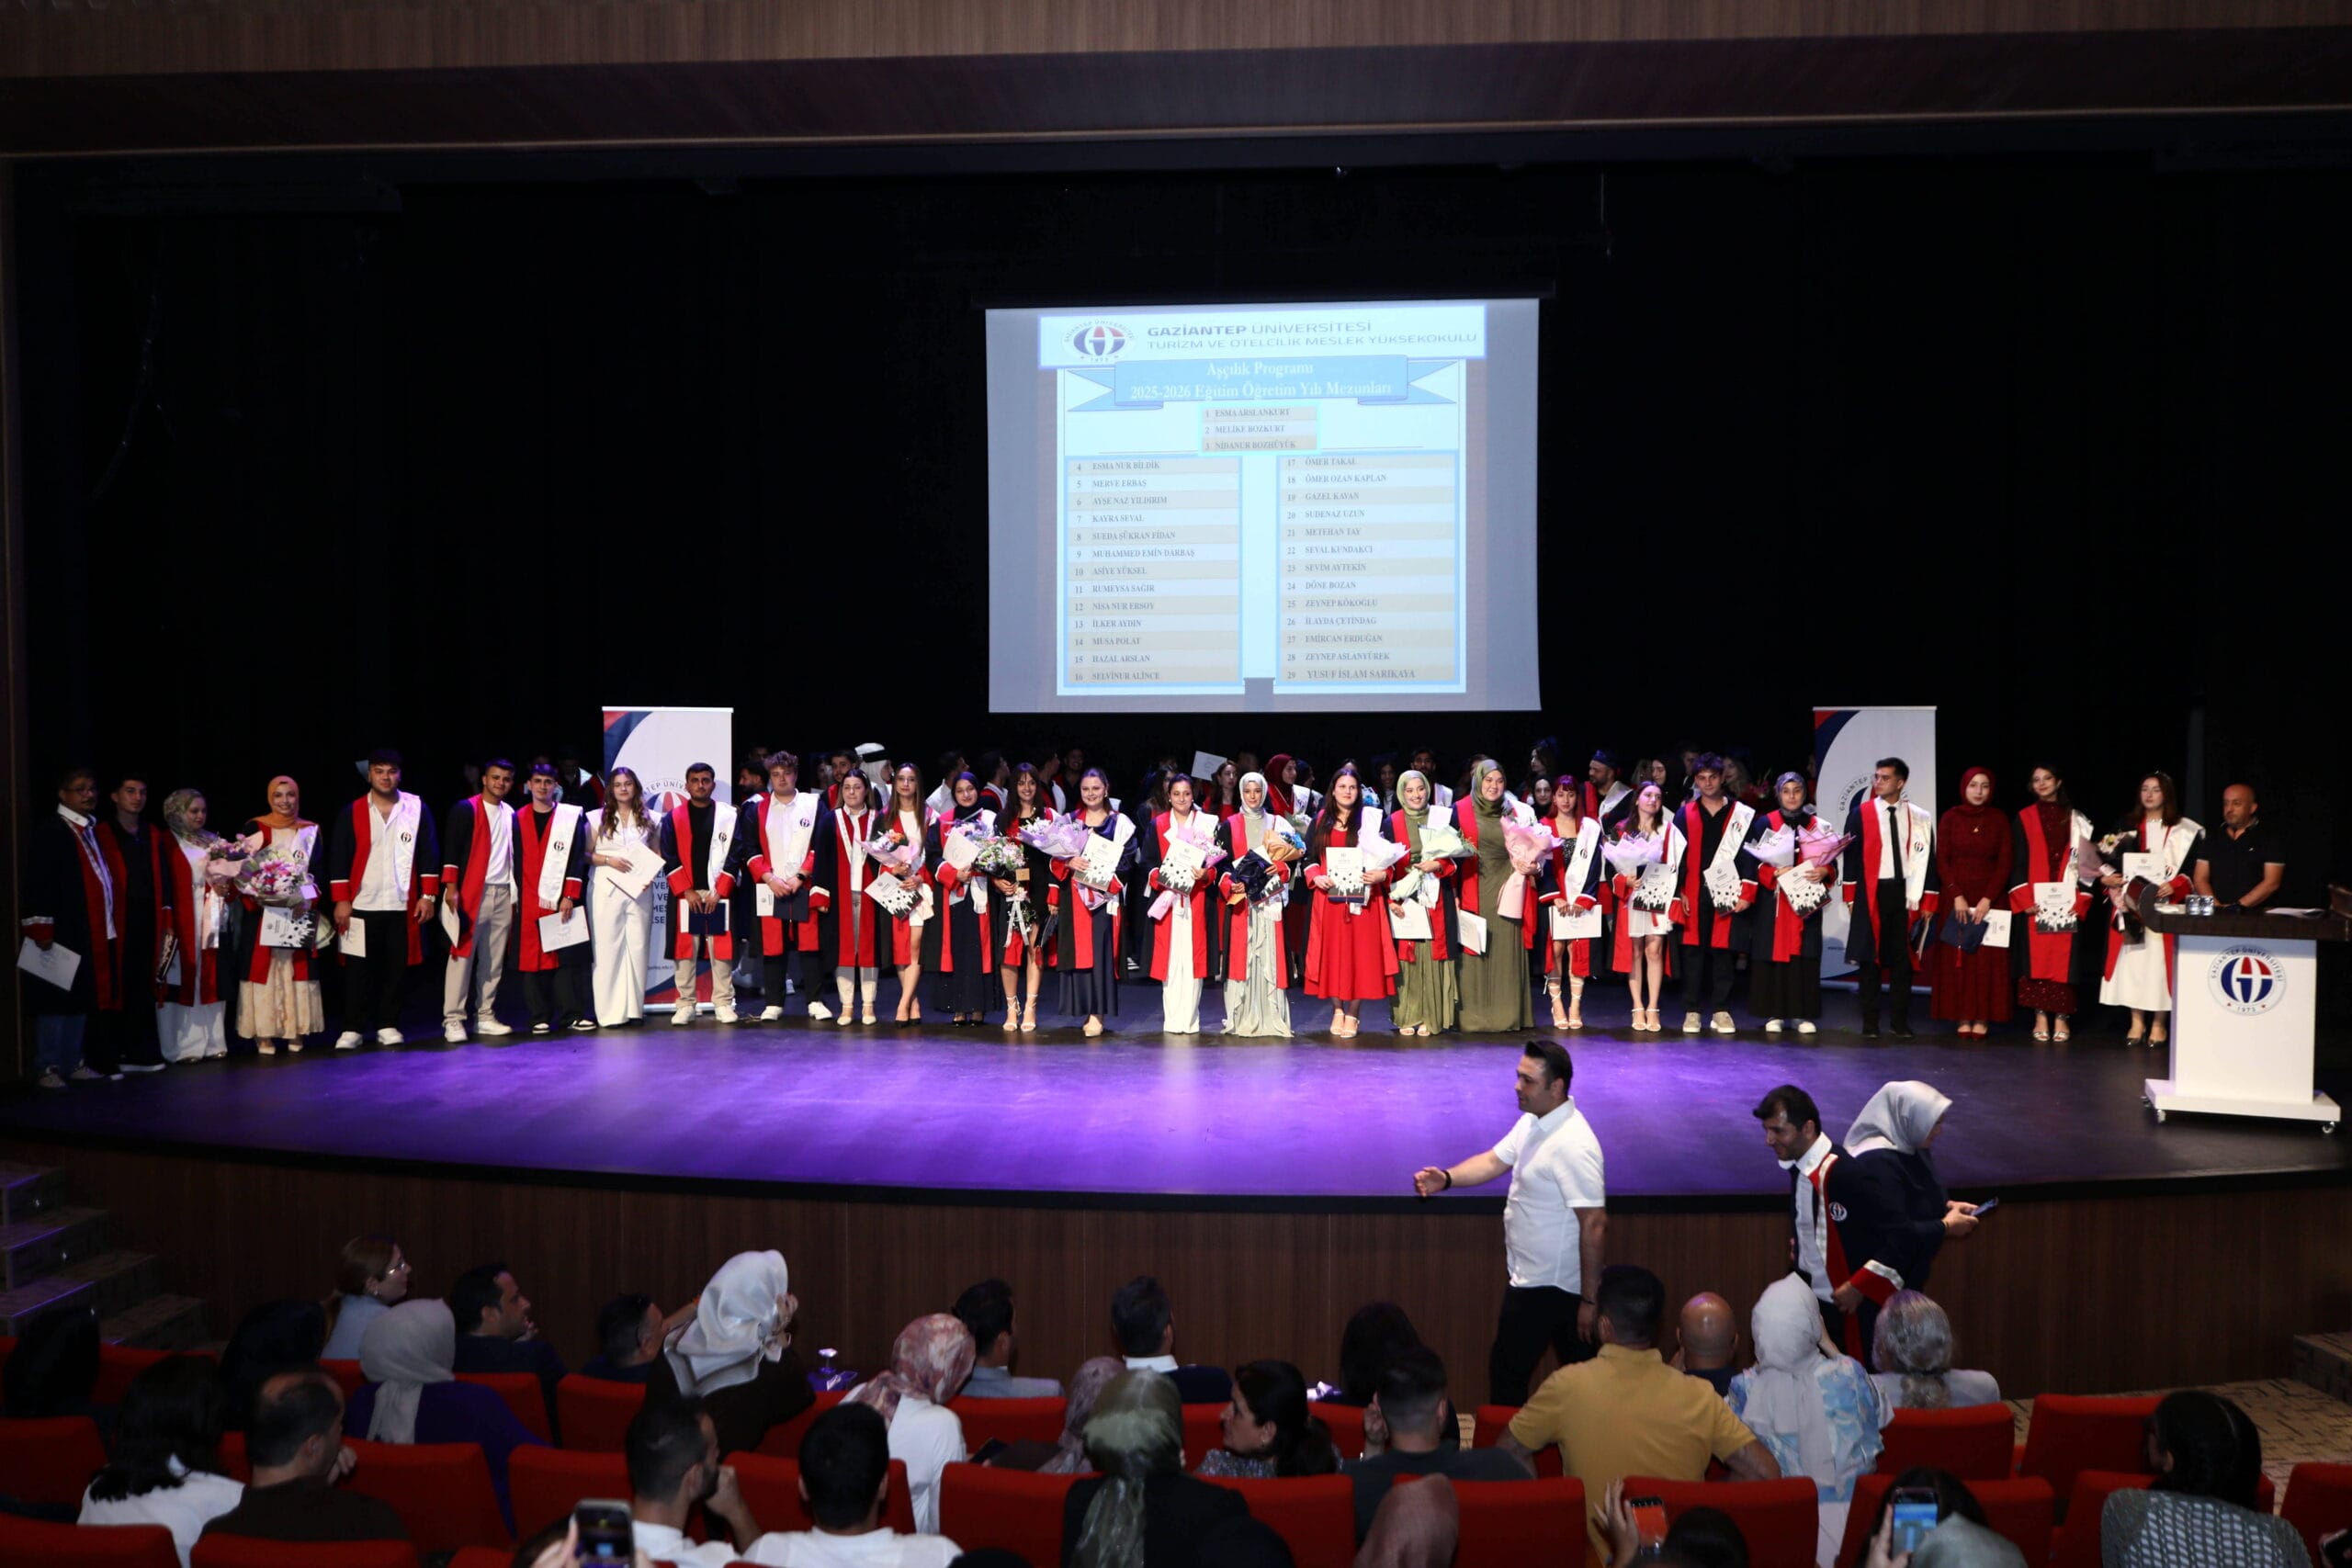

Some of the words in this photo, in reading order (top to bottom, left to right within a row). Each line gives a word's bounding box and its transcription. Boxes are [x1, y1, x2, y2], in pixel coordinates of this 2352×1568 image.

[1148, 323, 1247, 337] GAZİANTEP
[1251, 319, 1372, 334] ÜNİVERSİTESİ
[1147, 338, 1204, 350] TURİZM
[1207, 338, 1227, 349] VE
[1305, 335, 1364, 346] MESLEK
[1368, 333, 1477, 344] YÜKSEKOKULU
[1206, 363, 1250, 378] Aşçılık
[1254, 362, 1314, 378] Programı
[1131, 385, 1192, 399] 2025-2026
[1195, 383, 1238, 401] Eğitim
[1242, 381, 1296, 400] Öğretim
[1300, 382, 1323, 396] Yılı
[1326, 381, 1392, 396] Mezunları
[1215, 410, 1238, 418] ESMA
[1238, 408, 1290, 417] ARSLANKURT
[1215, 424, 1246, 434] MELİKE
[1248, 424, 1285, 433] BOZKURT
[1076, 463, 1081, 471] 4
[1092, 462, 1114, 470] ESMA
[1115, 461, 1132, 469] NUR
[1133, 459, 1160, 469] BİLDİK
[1286, 458, 1295, 467] 17
[1305, 456, 1329, 466] ÖMER
[1076, 479, 1081, 488] 5
[1092, 479, 1120, 488] MERVE
[1286, 476, 1295, 484] 18
[1305, 474, 1329, 483] ÖMER
[1330, 475, 1352, 483] OZAN
[1354, 474, 1386, 482] KAPLAN
[1076, 498, 1081, 506] 6
[1114, 496, 1129, 505] NAZ
[1130, 496, 1168, 504] YILDIRIM
[1286, 493, 1295, 502] 19
[1305, 492, 1332, 501] GAZEL
[1076, 514, 1081, 523] 7
[1092, 514, 1119, 523] KAYRA
[1286, 512, 1295, 520] 20
[1305, 510, 1341, 518] SUDENAZ
[1343, 509, 1365, 518] UZUN
[1076, 534, 1081, 542] 8
[1092, 533, 1117, 541] SUEDA
[1152, 530, 1176, 539] FİDAN
[1286, 528, 1295, 536] 21
[1305, 527, 1344, 536] METEHAN
[1346, 527, 1362, 536] TAY
[1076, 550, 1081, 558] 9
[1092, 549, 1141, 558] MUHAMMED
[1142, 548, 1163, 557] EMİN
[1164, 549, 1195, 558] DARBAŞ
[1286, 547, 1295, 555] 22
[1305, 546, 1329, 554] SEVAL
[1074, 568, 1084, 576] 10
[1092, 566, 1115, 575] ASİYE
[1116, 565, 1148, 574] YÜKSEL
[1286, 564, 1295, 572] 23
[1305, 562, 1330, 571] SEVİM
[1331, 561, 1367, 570] AYTEKİN
[1074, 585, 1084, 593] 11
[1092, 584, 1131, 592] RUMEYSA
[1286, 581, 1295, 590] 24
[1305, 580, 1328, 589] DÖNE
[1329, 581, 1357, 589] BOZAN
[1074, 603, 1084, 611] 12
[1092, 601, 1111, 610] NİSA
[1112, 602, 1128, 610] NUR
[1129, 602, 1155, 610] ERSOY
[1286, 600, 1295, 608] 25
[1305, 599, 1336, 607] ZEYNEP
[1074, 621, 1084, 629] 13
[1092, 618, 1117, 627] İLKER
[1117, 619, 1142, 627] AYDIN
[1286, 617, 1295, 626] 26
[1305, 615, 1334, 625] İLAYDA
[1074, 638, 1084, 647] 14
[1092, 637, 1114, 646] MUSA
[1115, 637, 1141, 645] POLAT
[1286, 636, 1295, 644] 27
[1305, 633, 1342, 643] EMİRCAN
[1092, 655, 1119, 663] HAZAL
[1120, 654, 1151, 662] ARSLAN
[1286, 653, 1295, 661] 28
[1305, 652, 1336, 660] ZEYNEP
[1337, 650, 1390, 660] ASLANYÜREK
[1074, 673, 1084, 682] 16
[1091, 671, 1130, 681] SELVİNUR
[1131, 671, 1160, 680] ALİNCE
[1286, 671, 1295, 680] 29
[1307, 670, 1337, 679] YUSUF
[1338, 668, 1368, 679] İSLAM
[1369, 670, 1416, 679] SARIKAYA
